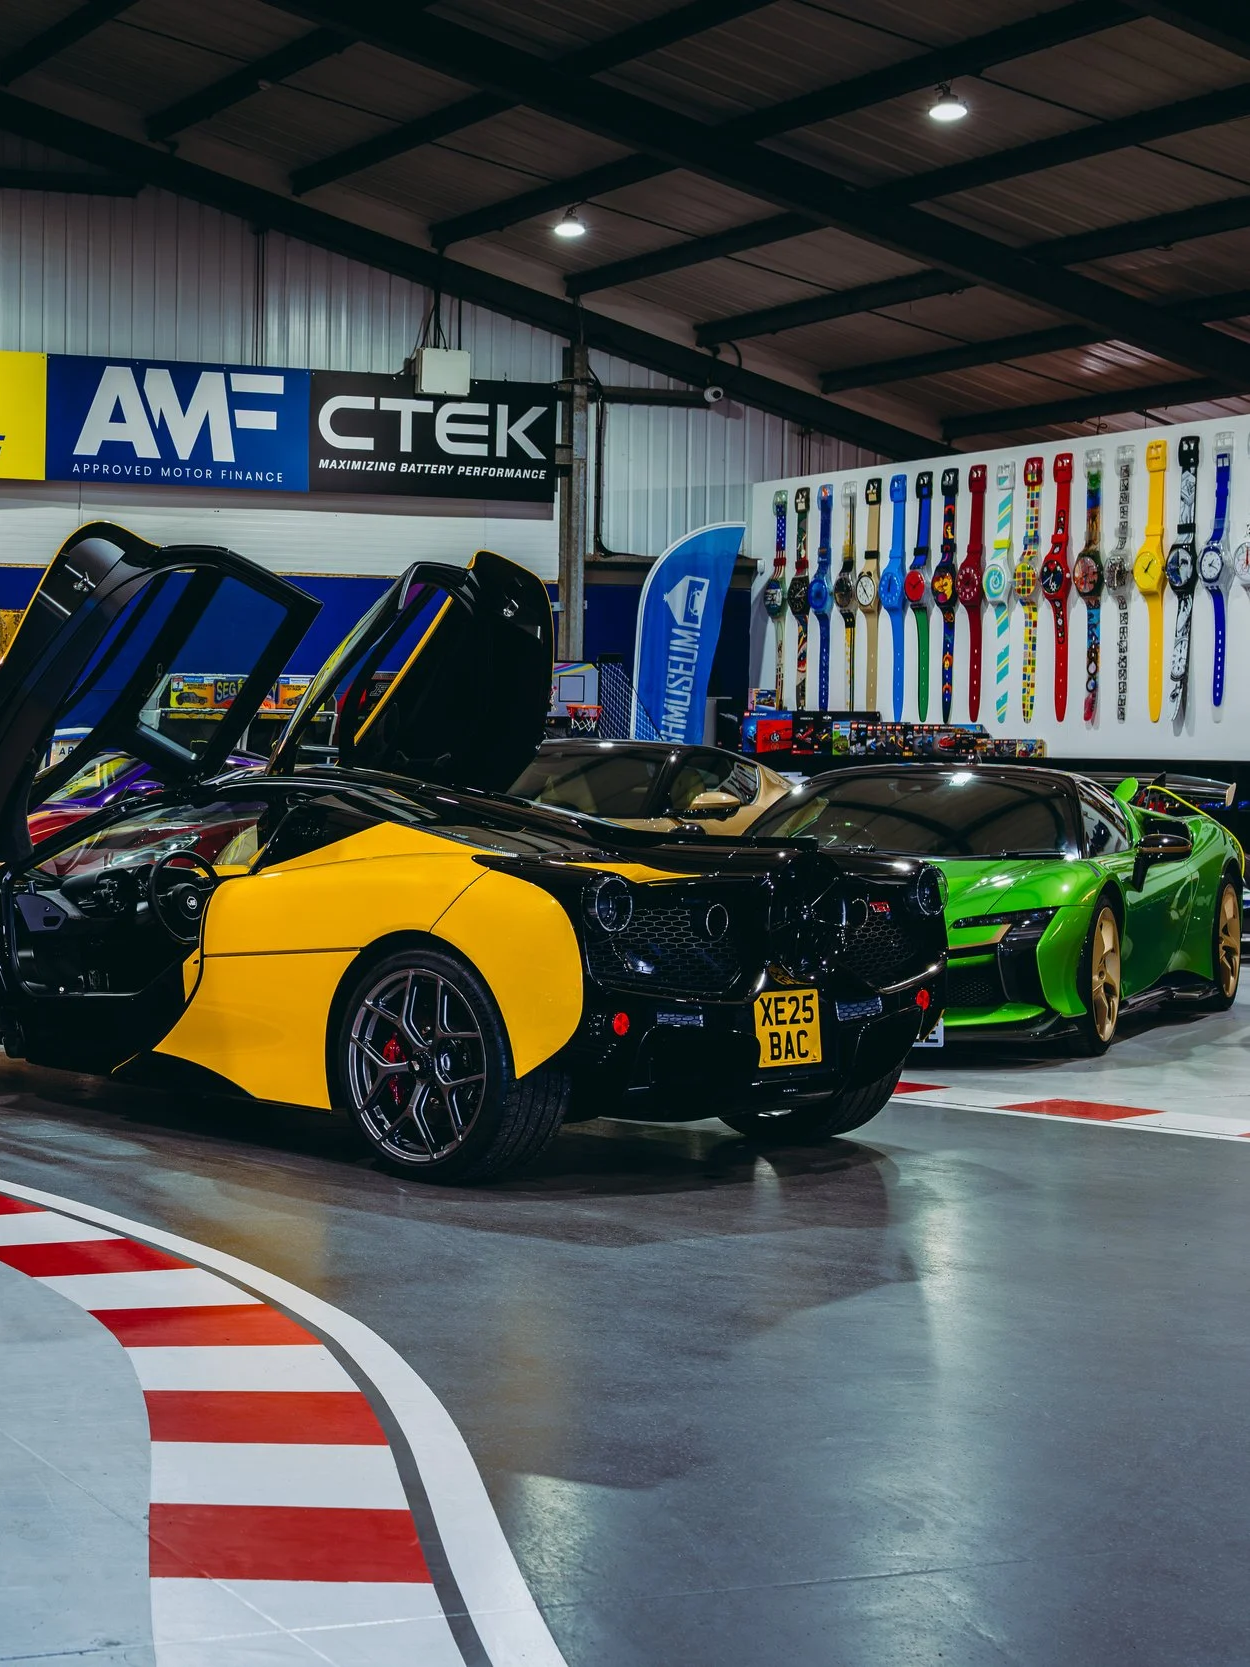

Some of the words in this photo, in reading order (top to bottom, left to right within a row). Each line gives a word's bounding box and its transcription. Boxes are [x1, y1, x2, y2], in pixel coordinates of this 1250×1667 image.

[72, 365, 285, 463] AMF
[318, 395, 548, 460] CTEK
[72, 463, 152, 476] APPROVED
[161, 467, 212, 479] MOTOR
[221, 470, 283, 483] FINANCE
[318, 458, 396, 472] MAXIMIZING
[400, 462, 454, 475] BATTERY
[457, 466, 547, 480] PERFORMANCE
[759, 994, 814, 1027] XE25
[768, 1030, 809, 1061] BAC
